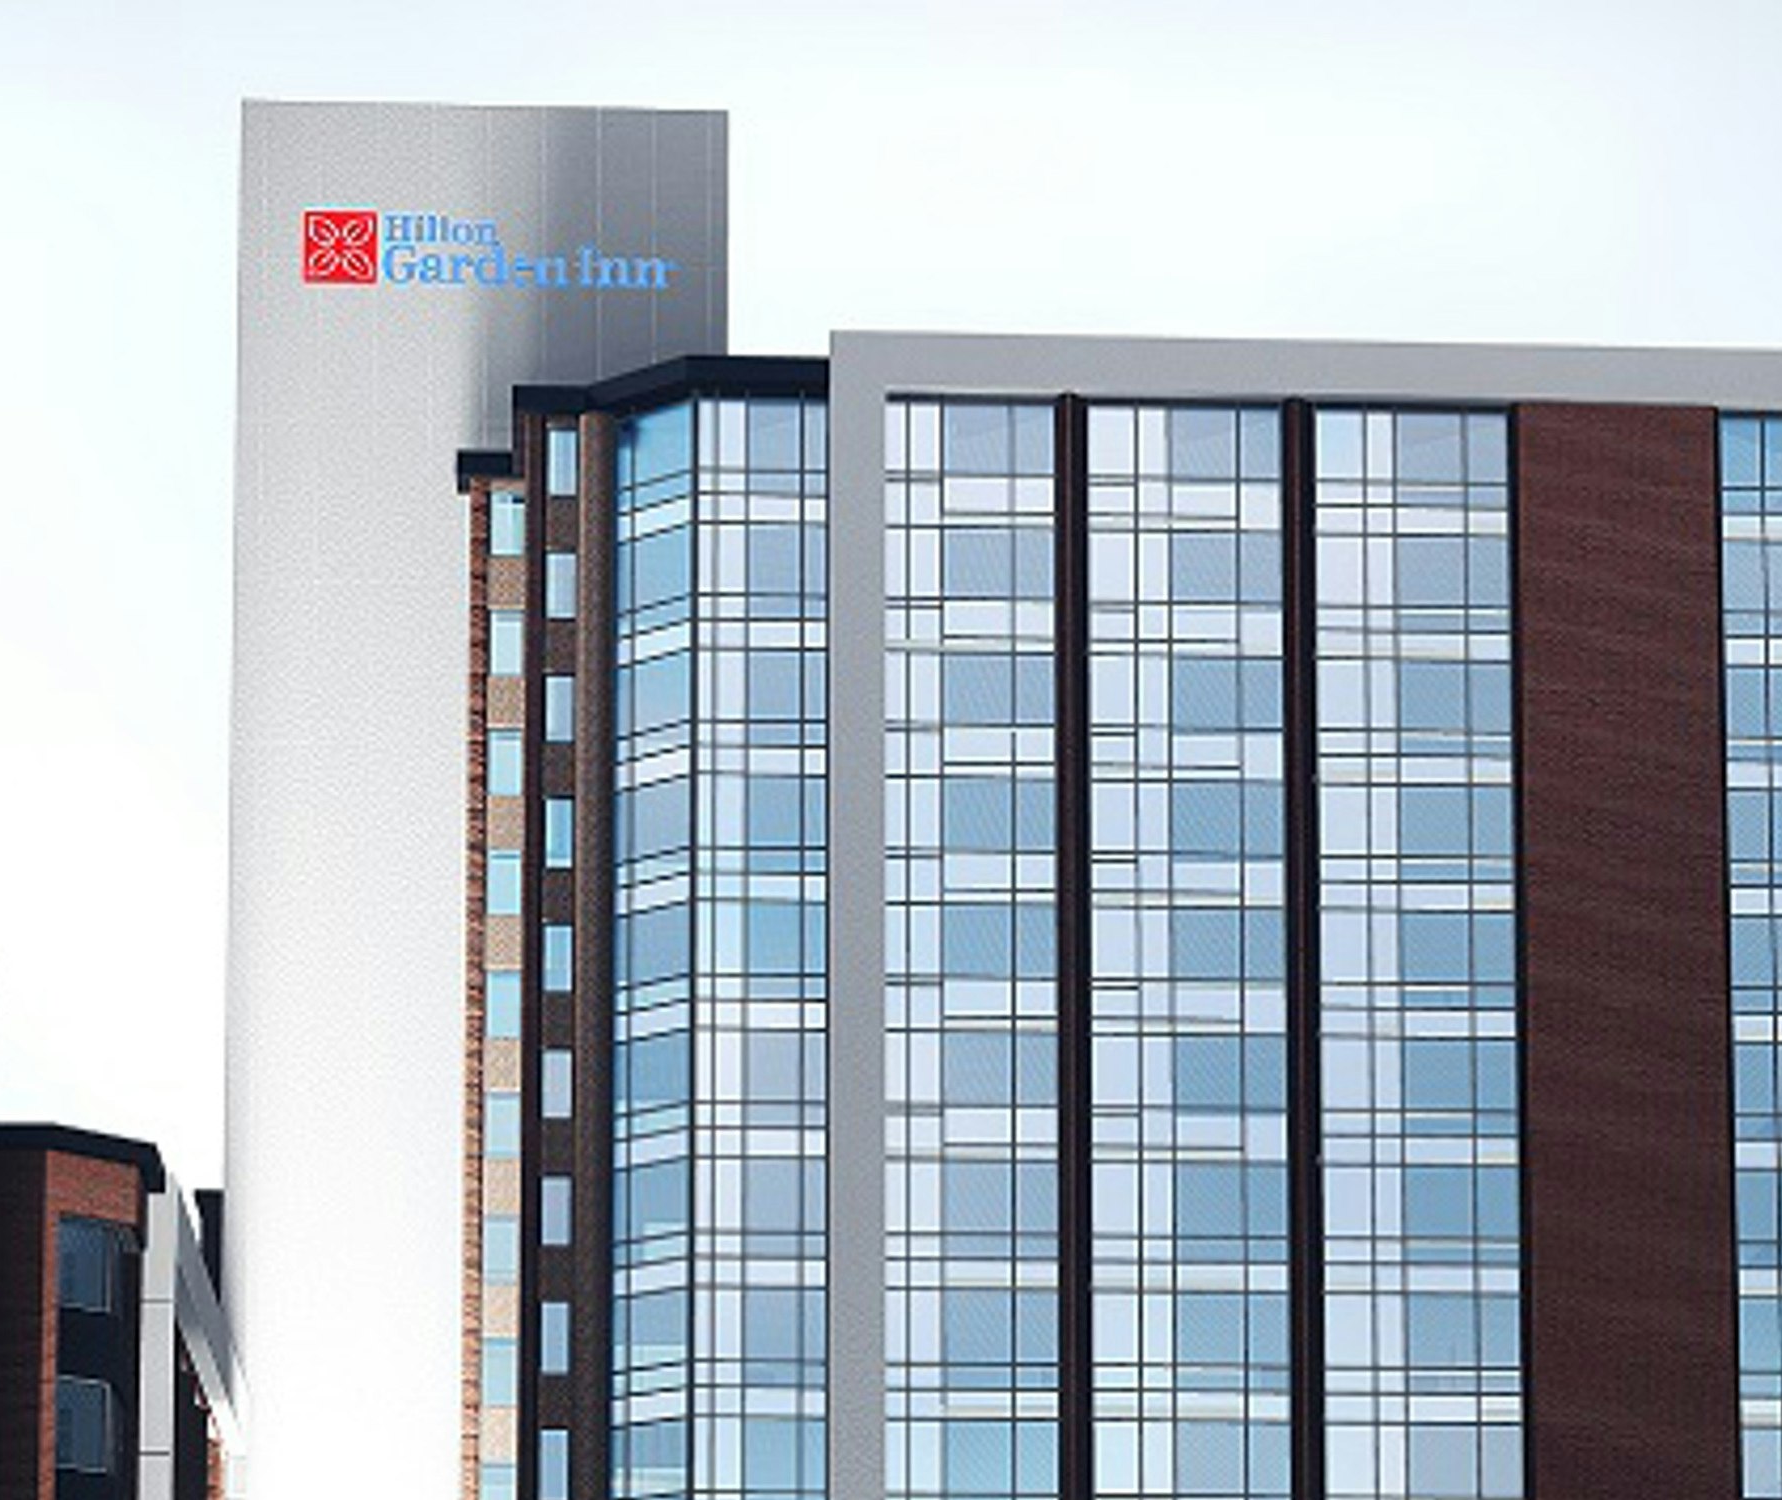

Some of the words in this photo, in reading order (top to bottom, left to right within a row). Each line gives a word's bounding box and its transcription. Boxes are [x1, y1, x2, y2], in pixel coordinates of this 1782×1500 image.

[383, 215, 499, 245] Hilton
[382, 244, 569, 288] Garden
[577, 241, 679, 289] Inn
